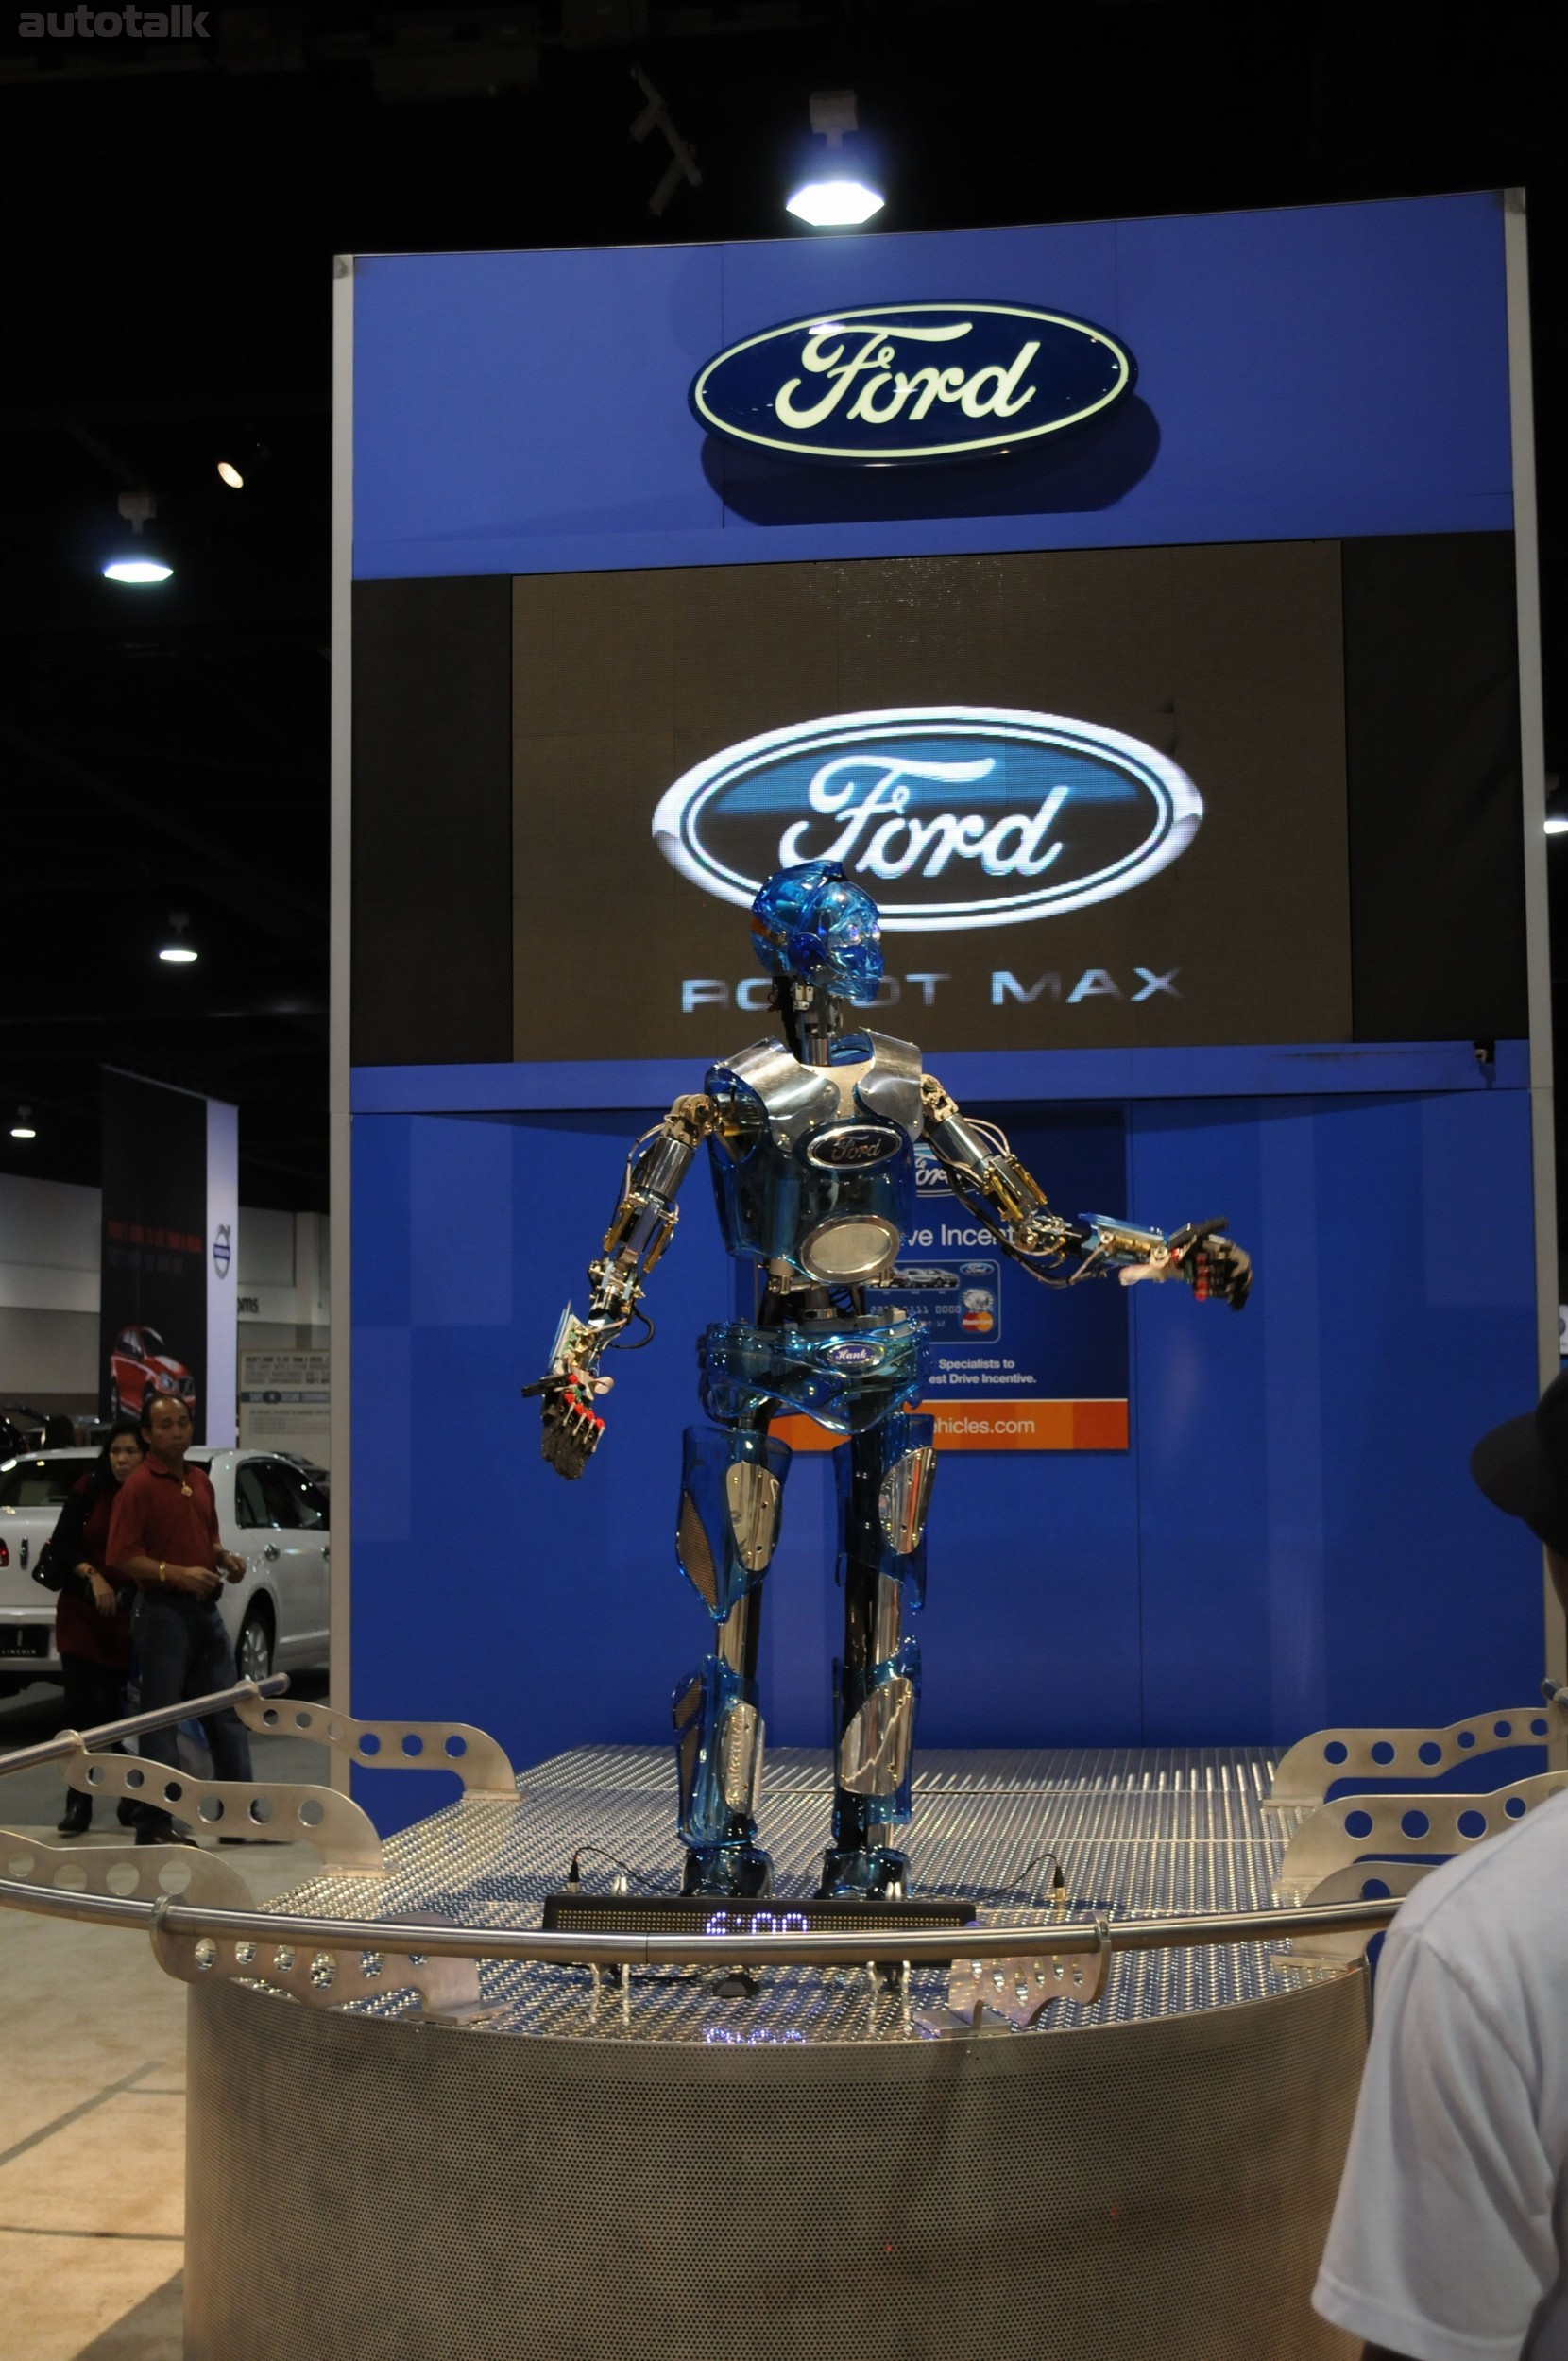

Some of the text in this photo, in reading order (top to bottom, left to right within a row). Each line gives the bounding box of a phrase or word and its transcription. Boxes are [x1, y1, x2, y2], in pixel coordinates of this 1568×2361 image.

[775, 322, 1041, 429] Ford
[779, 755, 1069, 879] Ford
[991, 967, 1169, 1005] MAX
[831, 1135, 882, 1161] Ford
[836, 1349, 868, 1360] Hank
[938, 1359, 1015, 1371] Specialists to
[929, 1373, 1037, 1384] est Drive Incentive.
